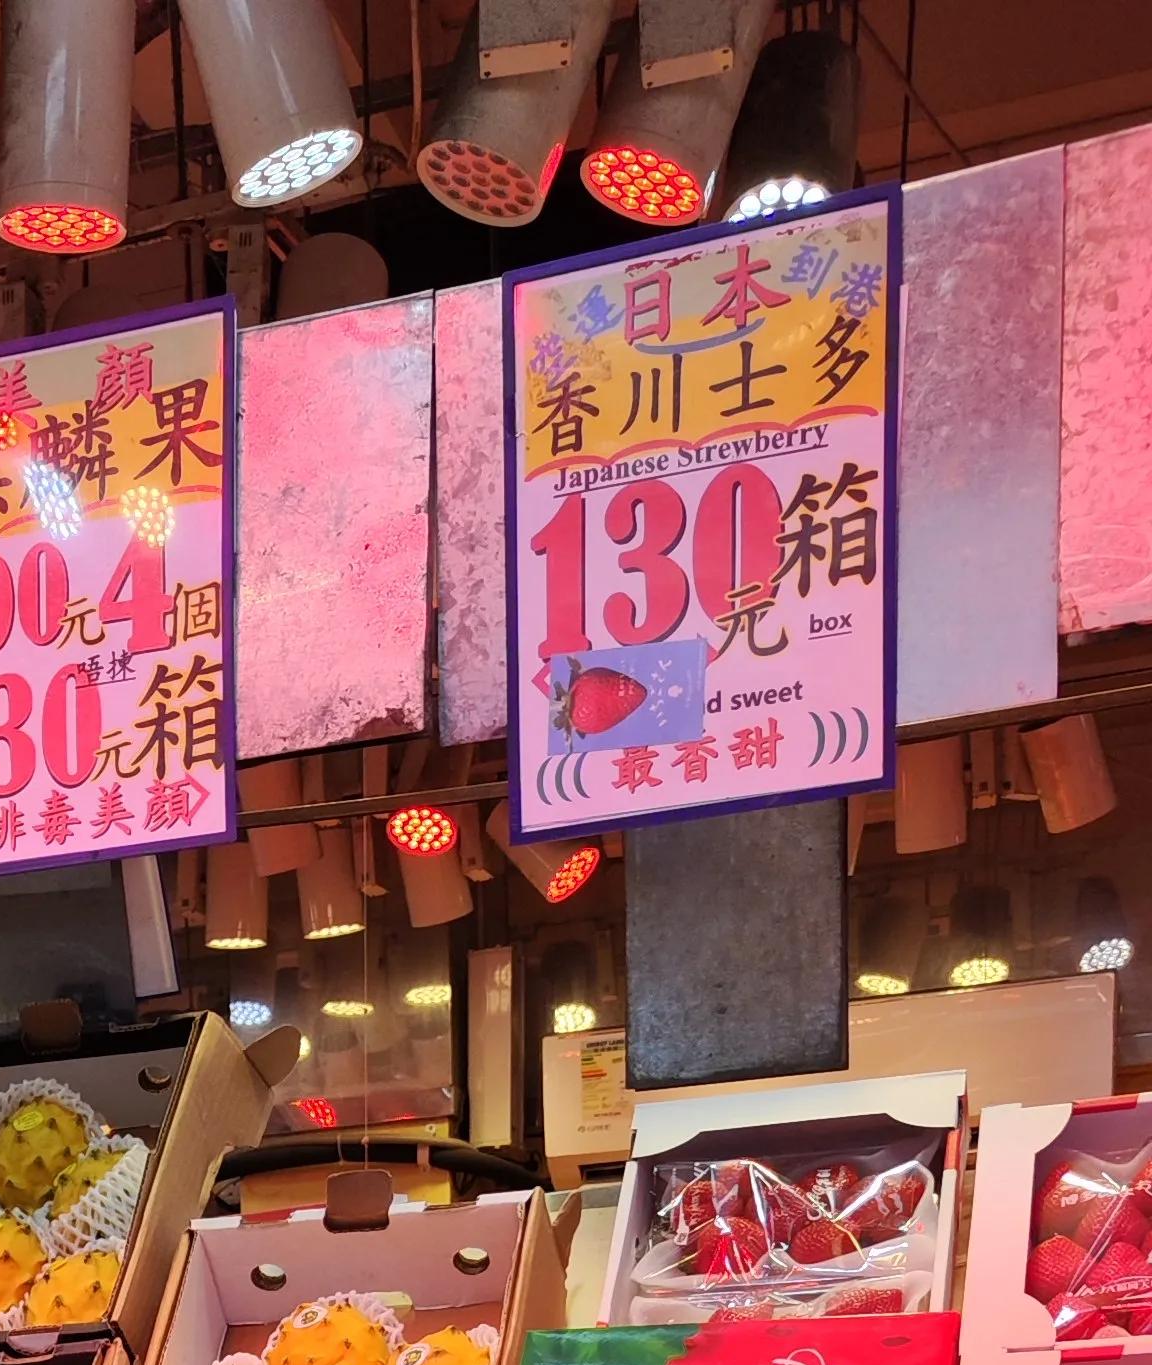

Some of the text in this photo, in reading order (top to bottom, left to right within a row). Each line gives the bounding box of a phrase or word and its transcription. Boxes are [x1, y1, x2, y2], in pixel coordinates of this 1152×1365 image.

[622, 244, 792, 346] 日本
[532, 315, 870, 457] 香川士多
[553, 421, 829, 492] Japanese Strewberry
[808, 609, 853, 636] box
[730, 680, 804, 712] sweet
